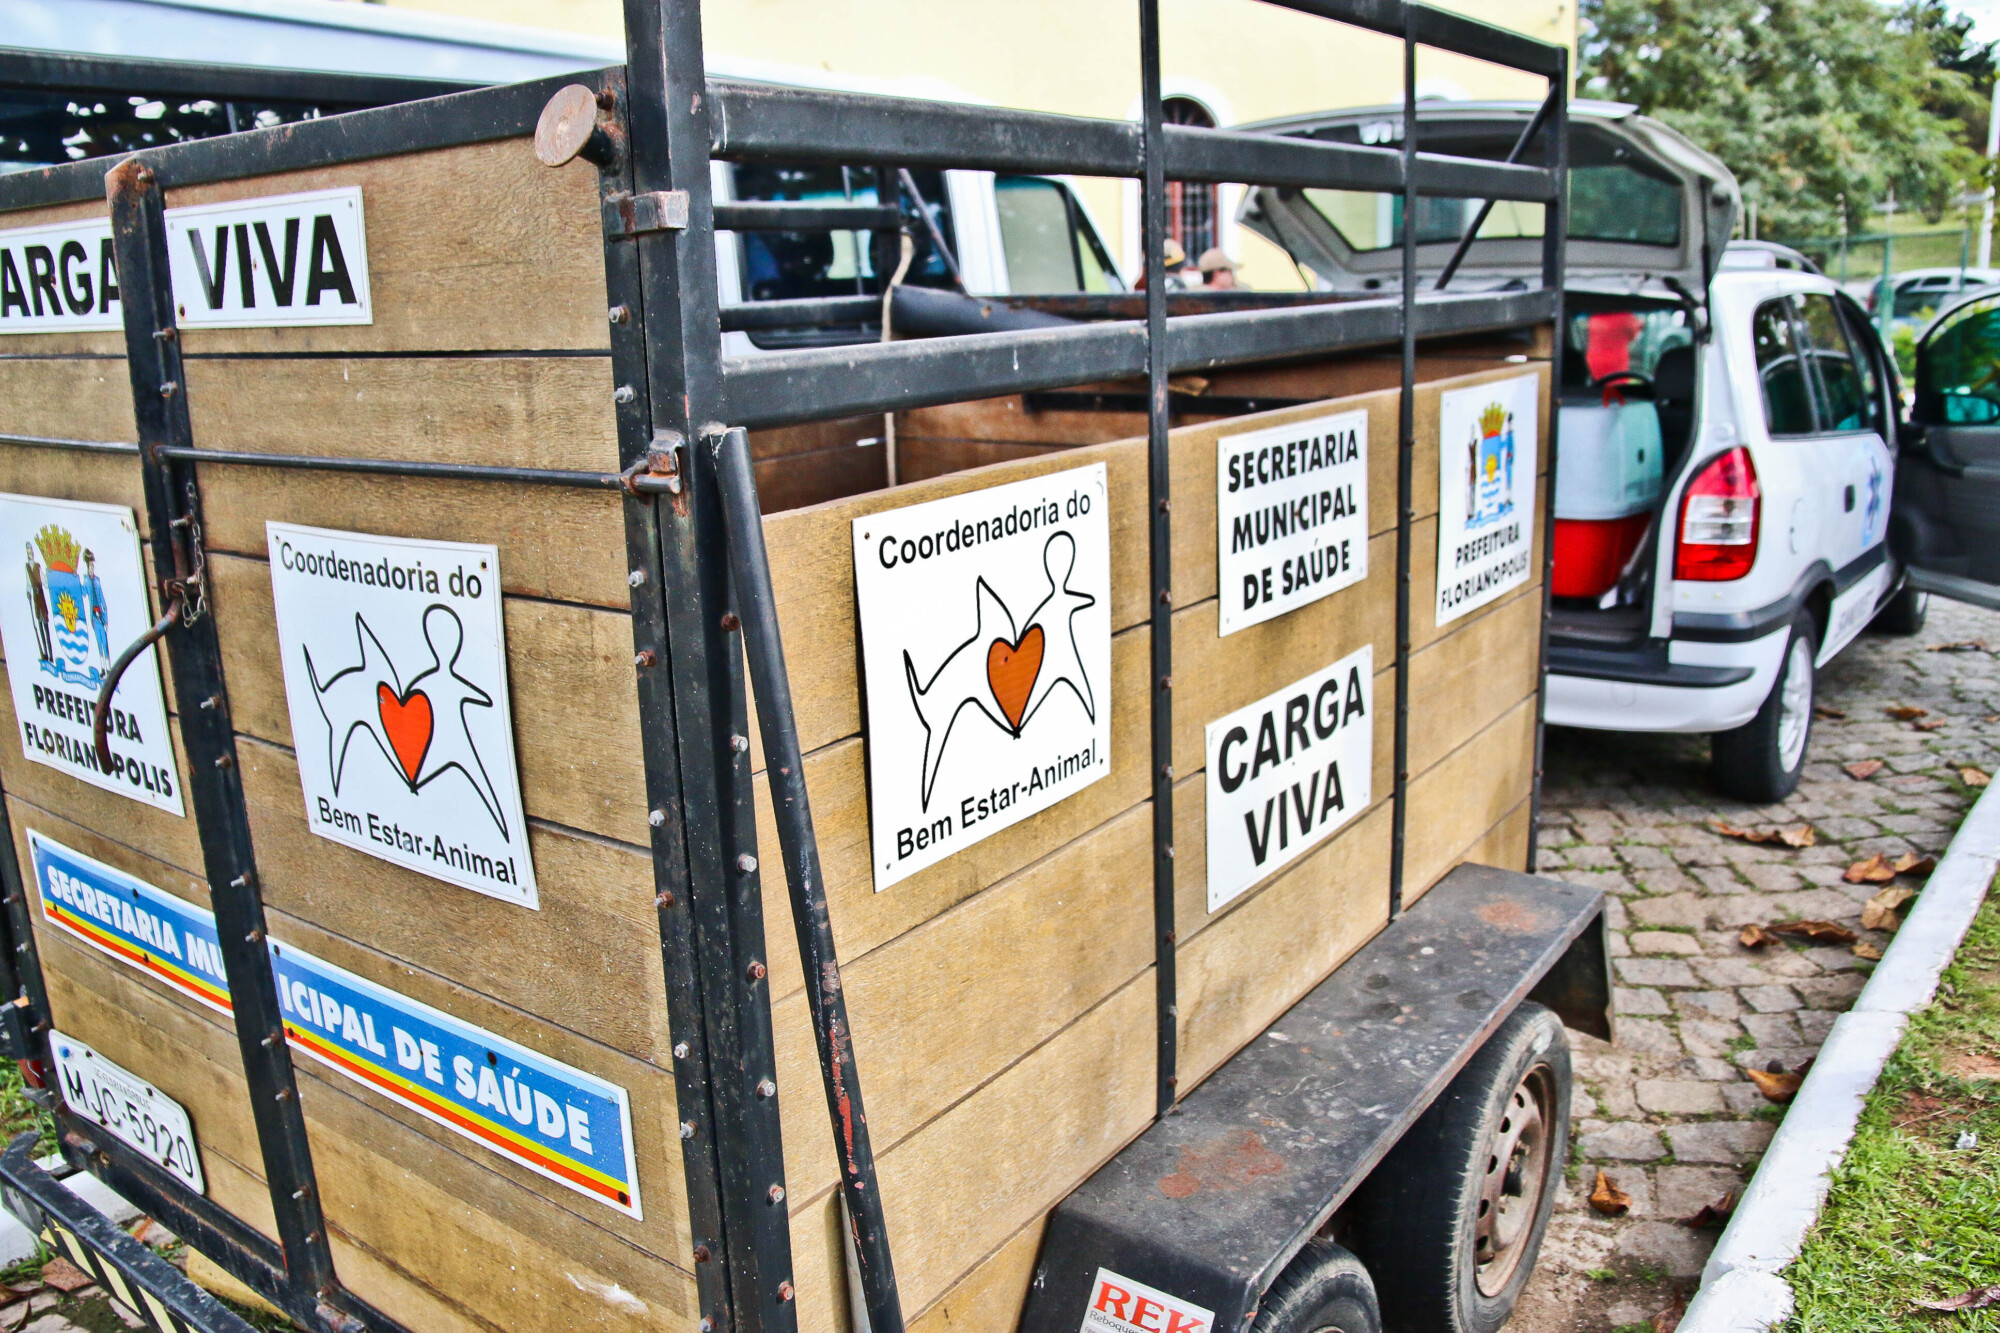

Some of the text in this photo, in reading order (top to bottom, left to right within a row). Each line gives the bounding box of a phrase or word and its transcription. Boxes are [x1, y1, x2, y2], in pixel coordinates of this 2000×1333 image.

[187, 215, 357, 310] VIVA
[1228, 429, 1359, 493] SECRETARIA
[878, 489, 1091, 569] Coordenadoria do
[1232, 484, 1357, 555] MUNICIPAL
[1455, 521, 1520, 569] PREFEITURA
[280, 542, 482, 599] Coordenadoria do
[1243, 538, 1350, 611] DE SAÚDE
[23, 721, 173, 798] FLORIANPOLIS
[1218, 665, 1366, 794] CARGA
[896, 738, 1097, 861] Bem Estar-Animal
[1243, 760, 1345, 867] VIVA
[317, 796, 518, 886] Bem Estar-Animal
[47, 865, 593, 1155] SECRETARIA MUICIPAL DE SAÚDE
[1089, 1310, 1141, 1333] Reboque
[1093, 1280, 1205, 1333] REK
